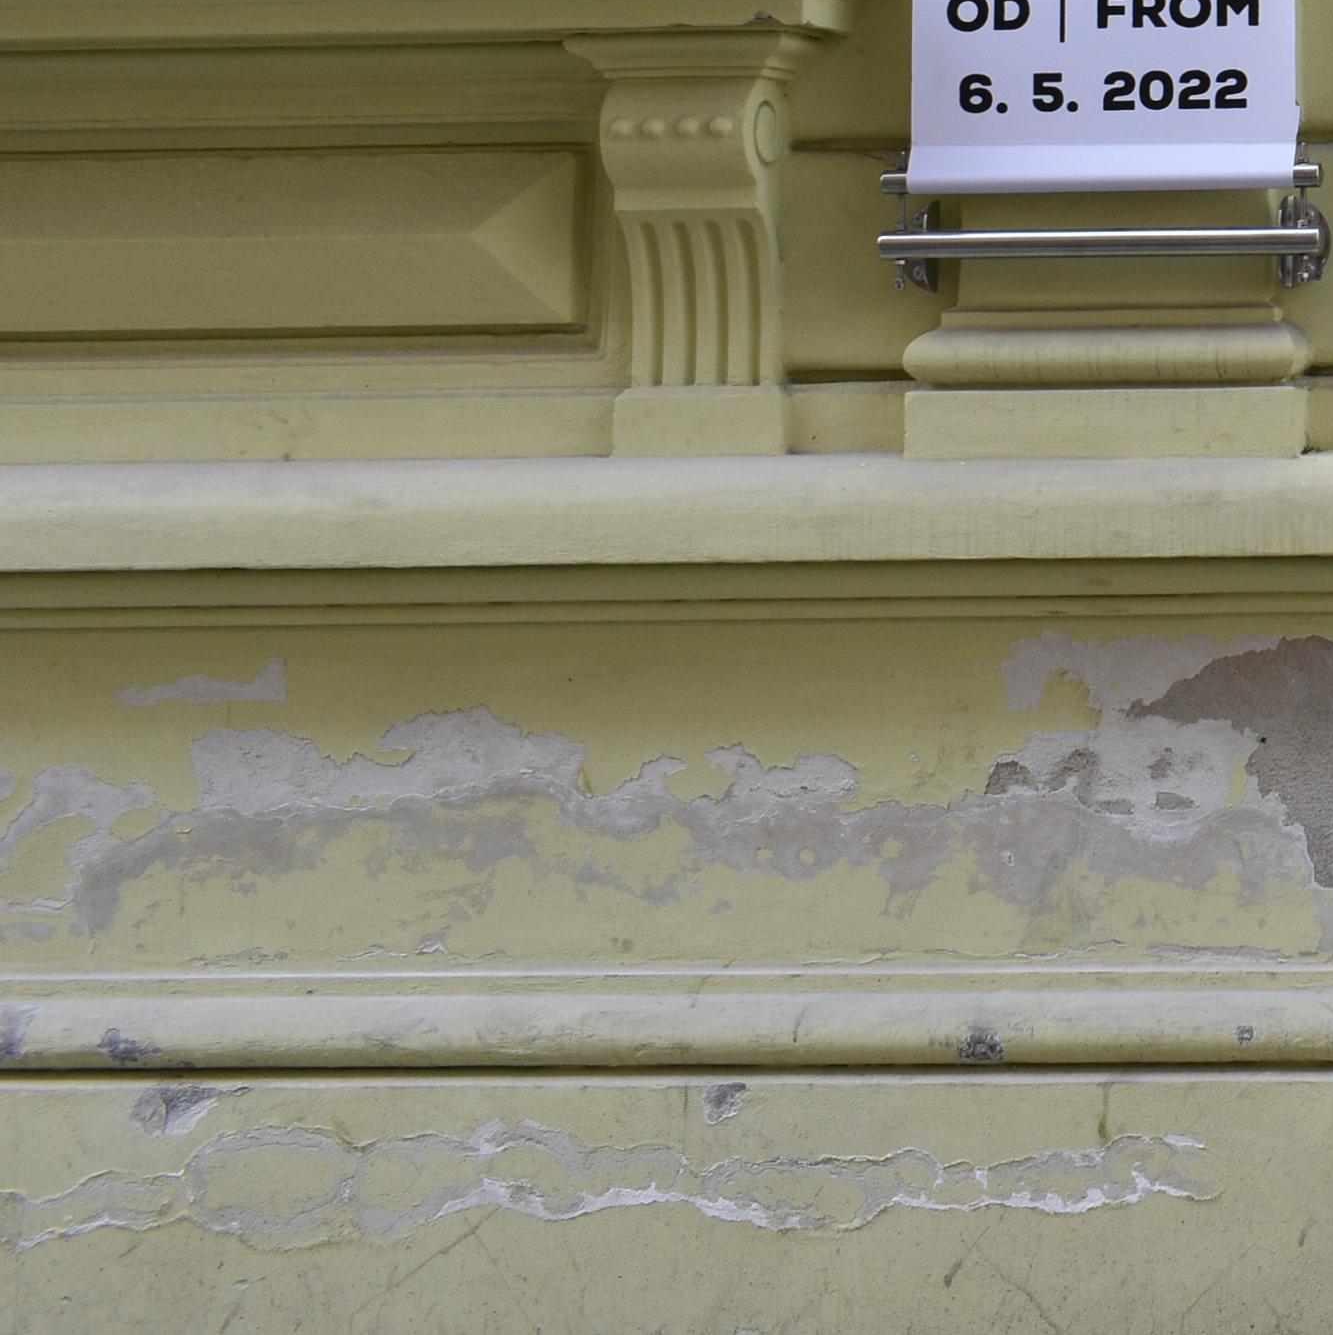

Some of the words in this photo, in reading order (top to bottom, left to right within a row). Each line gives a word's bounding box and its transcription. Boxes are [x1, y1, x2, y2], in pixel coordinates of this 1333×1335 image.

[959, 74, 1008, 114] 6.
[1032, 73, 1079, 112] 5.
[1103, 69, 1248, 111] 2022
